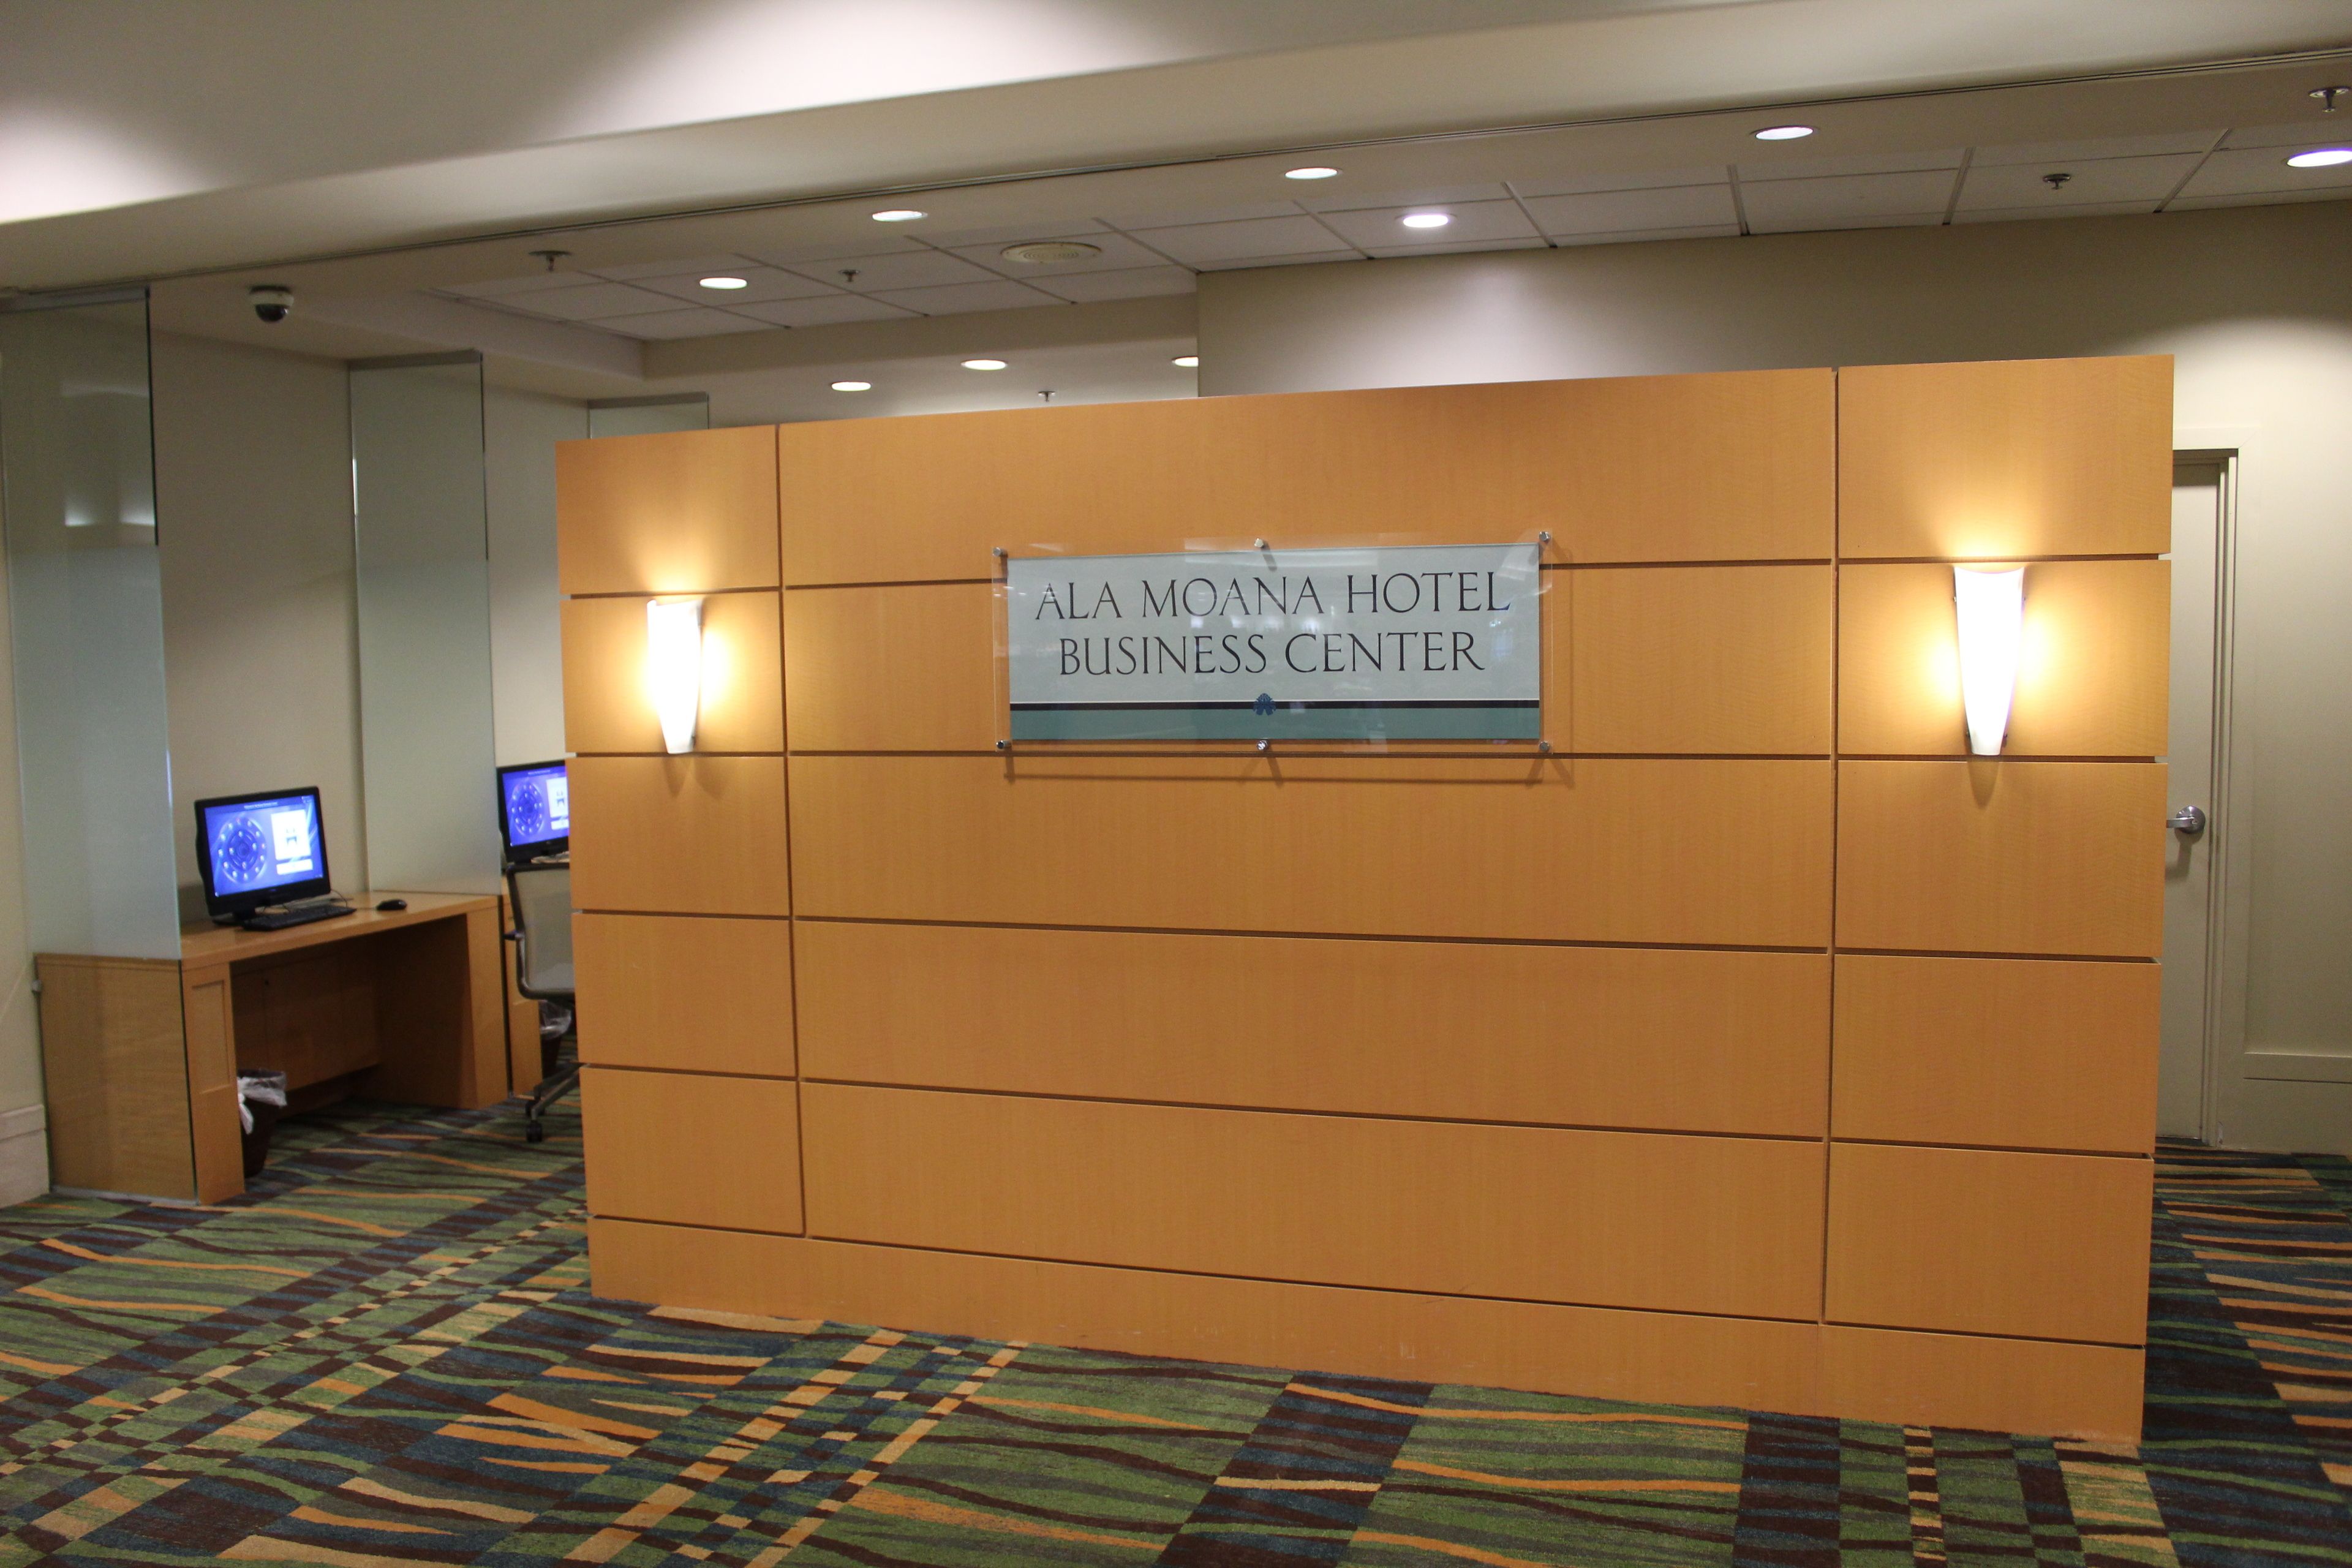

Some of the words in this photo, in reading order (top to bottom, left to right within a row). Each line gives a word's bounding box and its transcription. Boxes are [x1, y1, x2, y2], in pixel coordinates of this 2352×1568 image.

[1036, 582, 1121, 620] ALA
[1141, 576, 1324, 618] MOANA
[1347, 571, 1511, 613] HOTEL
[1060, 635, 1267, 675] BUSINESS
[1285, 631, 1485, 673] CENTER
